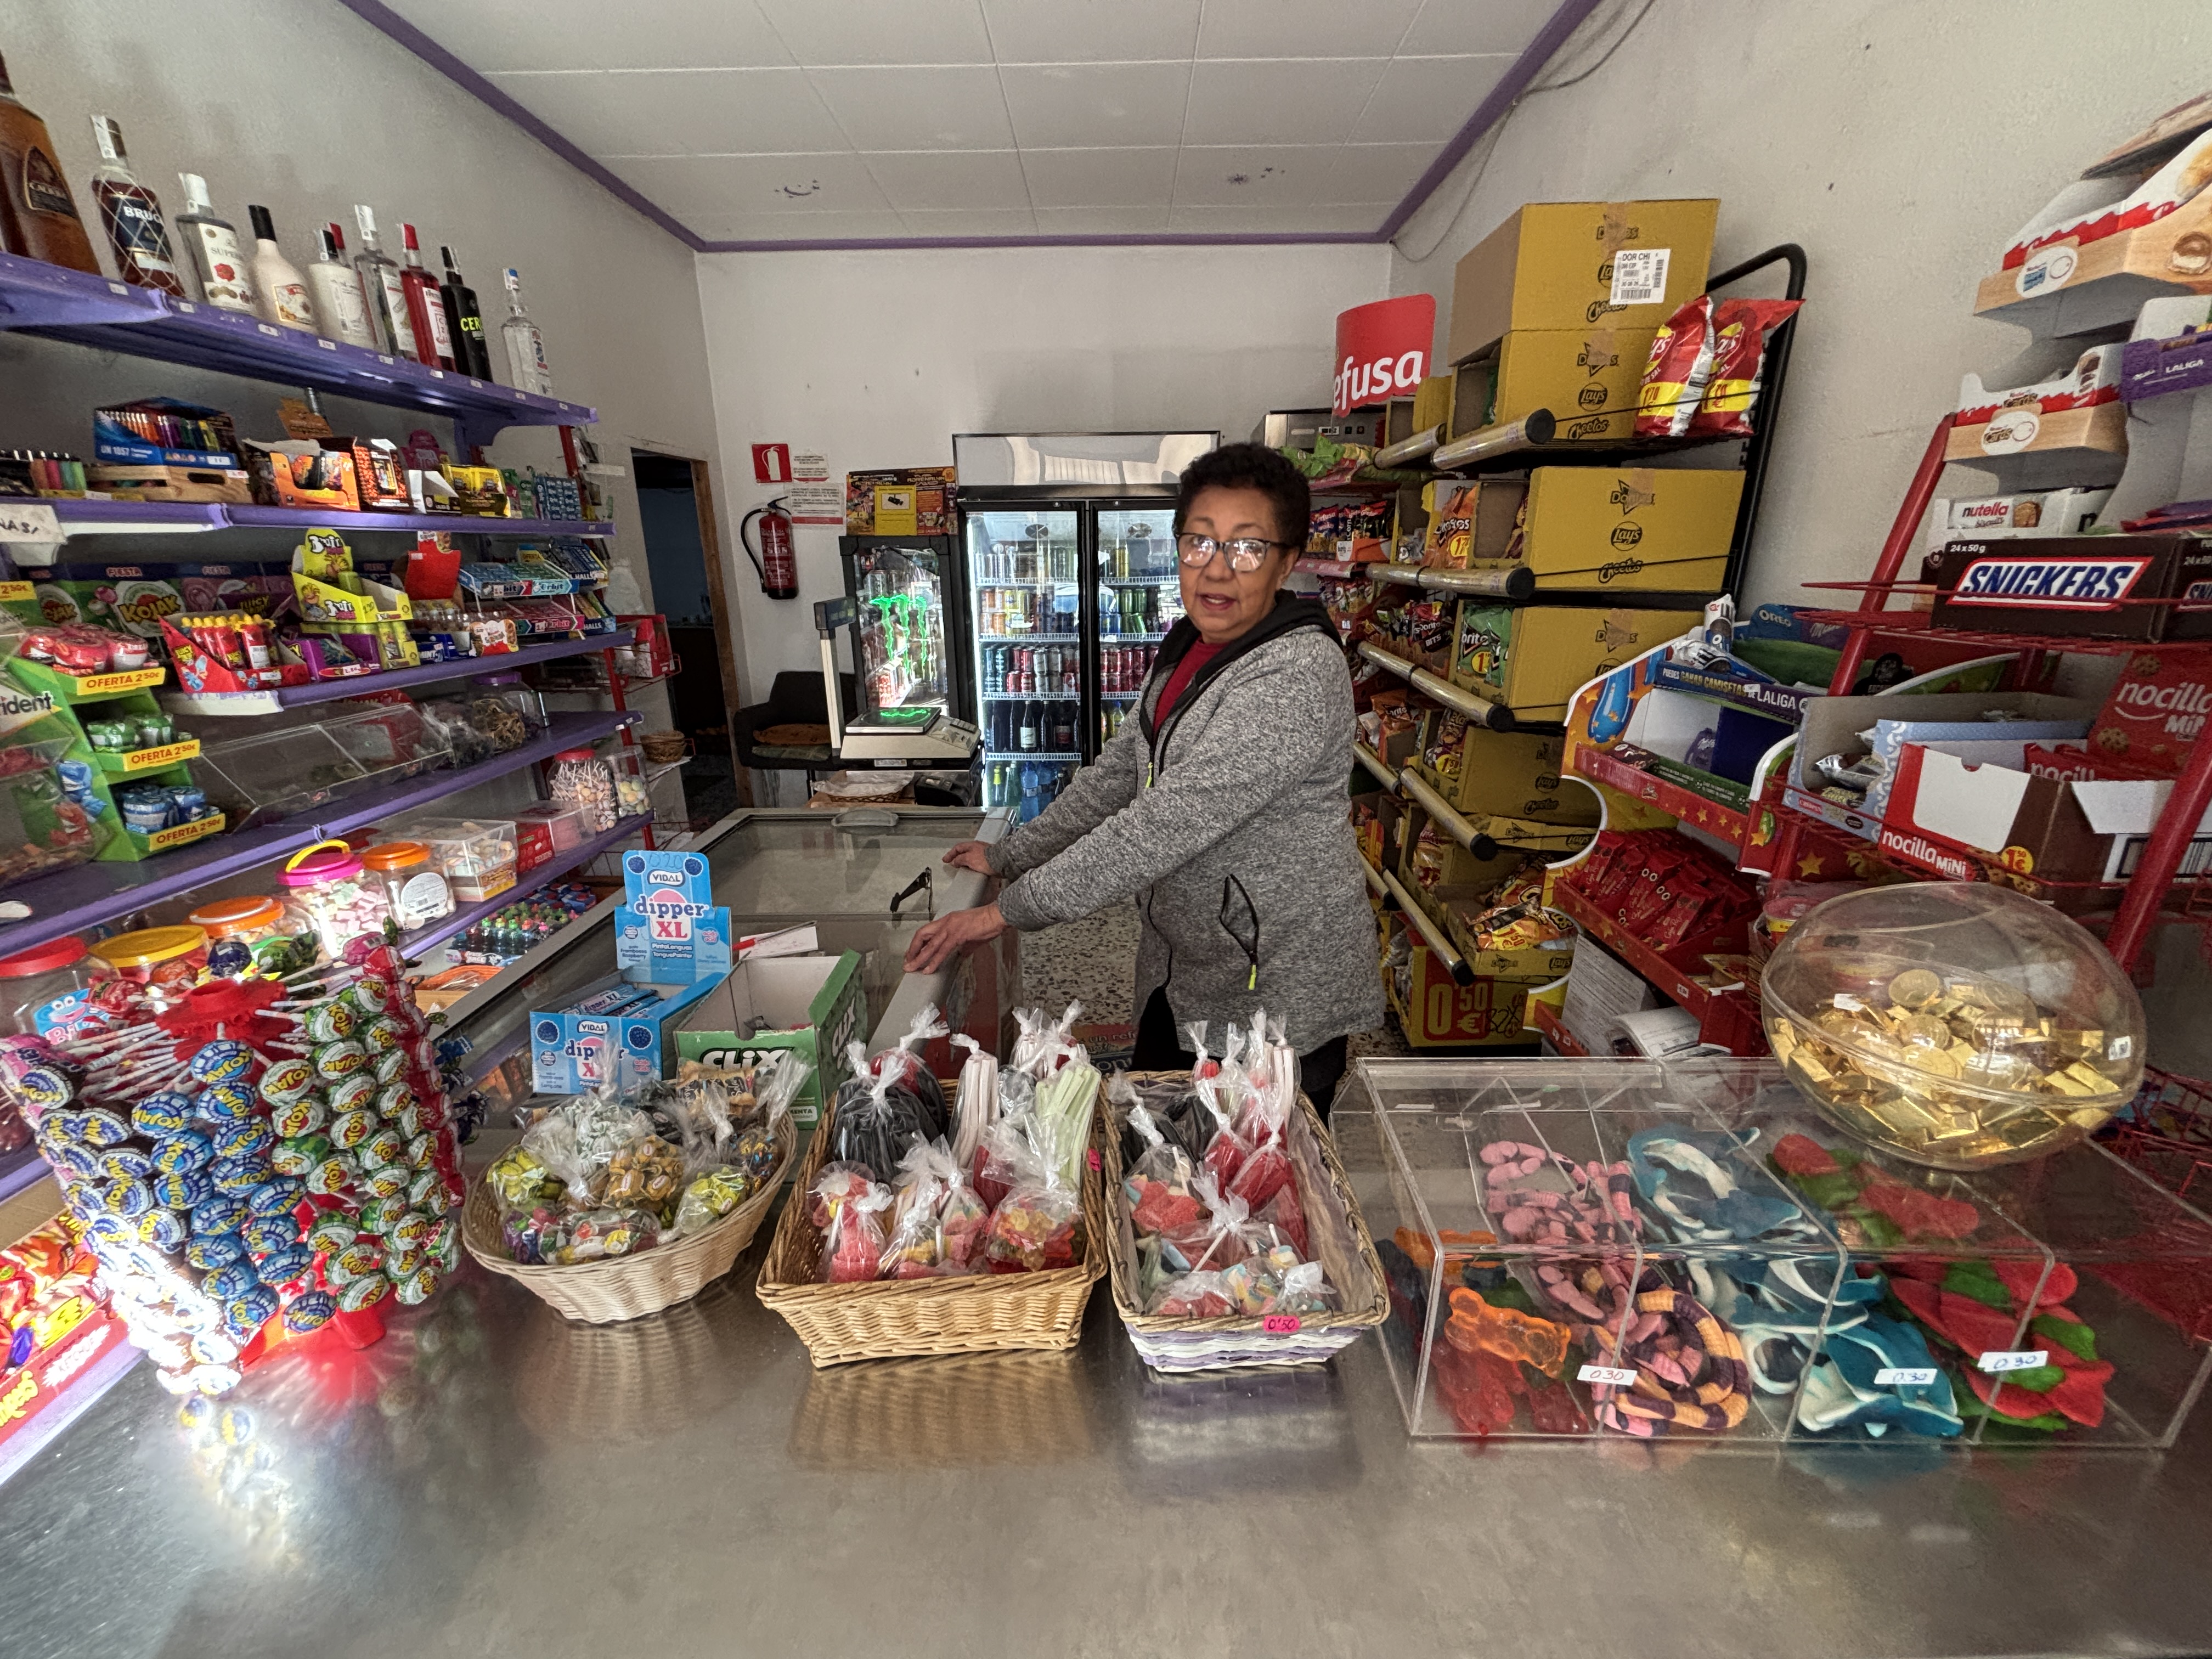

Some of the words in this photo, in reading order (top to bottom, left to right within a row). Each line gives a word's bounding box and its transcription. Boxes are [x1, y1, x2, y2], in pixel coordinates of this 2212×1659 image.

[2166, 358, 2204, 374] LALIGA
[1962, 503, 2009, 518] nutella
[1613, 529, 1641, 544] Lays
[1963, 565, 2134, 600] SNICKERS
[118, 594, 182, 624] KOJAK
[1759, 609, 1792, 628] OREO
[86, 674, 133, 688] OFERTA
[1662, 667, 1680, 680] PUEDES
[1680, 671, 1703, 686] GANAR
[1703, 676, 1747, 697] CAMISETAS
[1757, 687, 1797, 710] LALIGA
[131, 748, 172, 764] OFERTA
[156, 827, 198, 844] OFERTA
[1882, 830, 1937, 864] nocilla
[652, 873, 681, 882] VIDAL
[635, 895, 704, 919] dipper
[656, 921, 688, 939] XL
[582, 1023, 604, 1031] VIDAL
[565, 1040, 625, 1060] dipr
[264, 1064, 314, 1096] KOJAK
